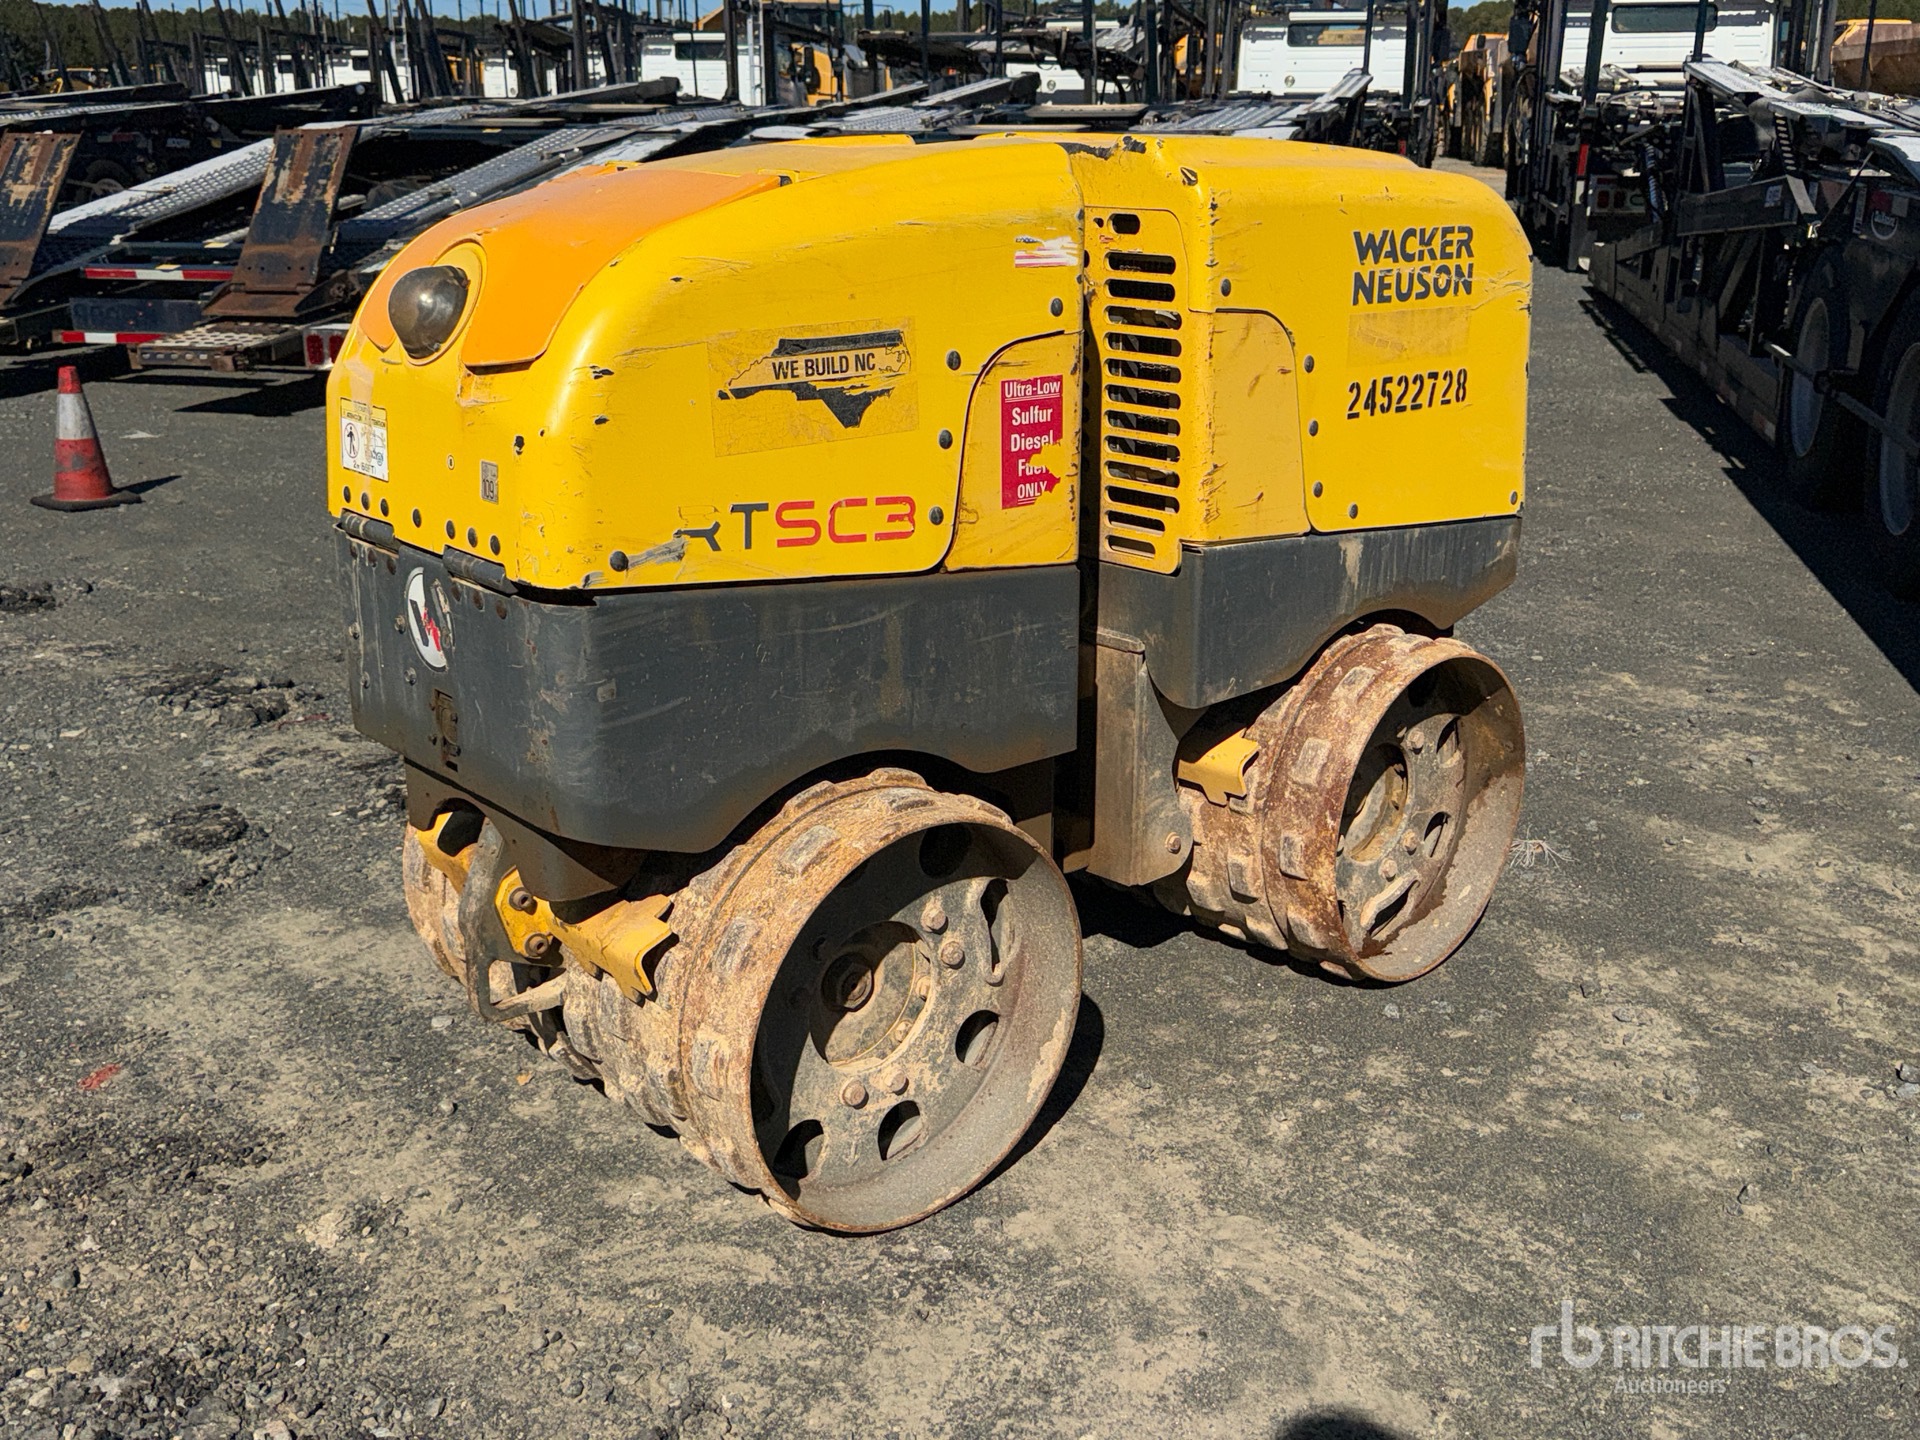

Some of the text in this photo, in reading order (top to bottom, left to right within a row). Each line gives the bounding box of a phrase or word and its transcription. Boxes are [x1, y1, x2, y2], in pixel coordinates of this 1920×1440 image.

[1353, 225, 1474, 265] WACKER
[1352, 263, 1474, 306] NEUSON
[771, 352, 876, 380] WE BUILD NC
[1004, 379, 1060, 398] Ultra-Low
[1347, 368, 1468, 420] 24522728
[1012, 405, 1053, 426] Sulfur
[1010, 430, 1054, 452] Diesel
[1017, 480, 1047, 499] ONLY
